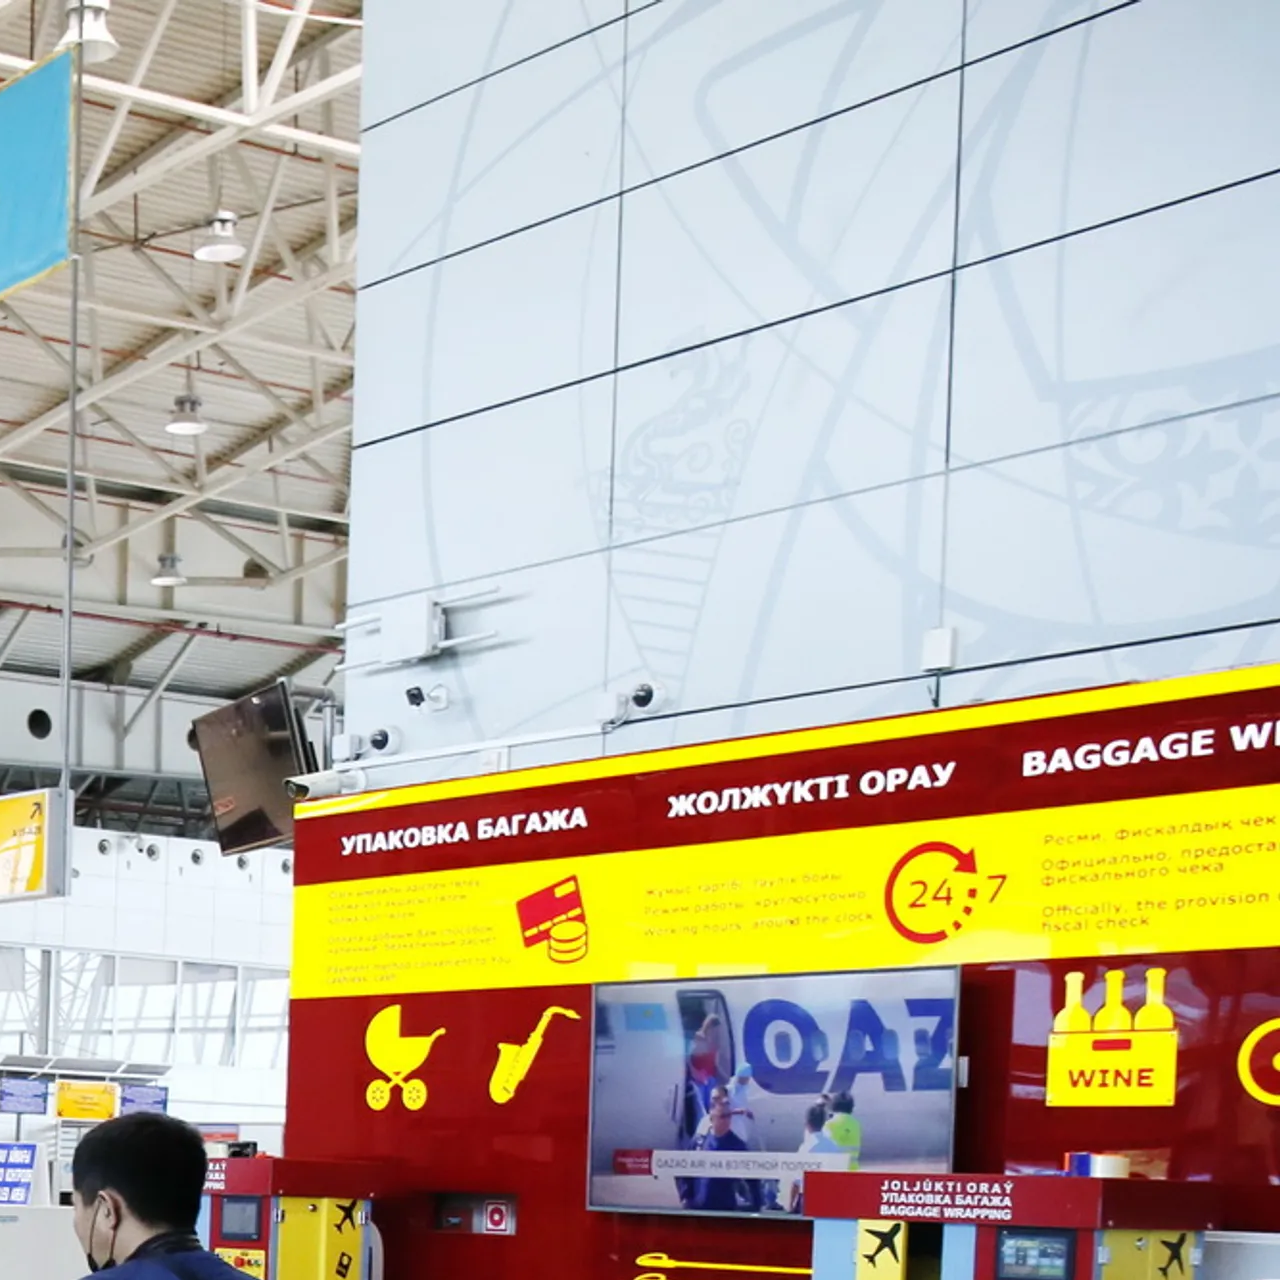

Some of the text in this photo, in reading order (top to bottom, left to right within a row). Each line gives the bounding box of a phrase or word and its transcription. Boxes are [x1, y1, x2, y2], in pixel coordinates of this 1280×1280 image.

[1021, 719, 1280, 778] BAGGAGE W
[859, 761, 957, 798] ОРАУ
[341, 805, 588, 856] УПАКОВКА БАГАЖА
[1239, 815, 1277, 827] чек
[1180, 839, 1280, 860] предоста
[1177, 860, 1225, 874] чека
[908, 874, 1008, 909] 24 7
[1136, 898, 1167, 911] the
[1174, 891, 1271, 911] provision
[752, 917, 801, 930] around
[806, 914, 830, 925] the
[834, 911, 874, 924] clock
[1041, 916, 1150, 933] fiscal check
[1068, 1068, 1155, 1089] WINE
[880, 1192, 1013, 1208] УПАКОВКА БАГАЖА
[879, 1204, 1012, 1221] BAGGAGE WRAPPING
